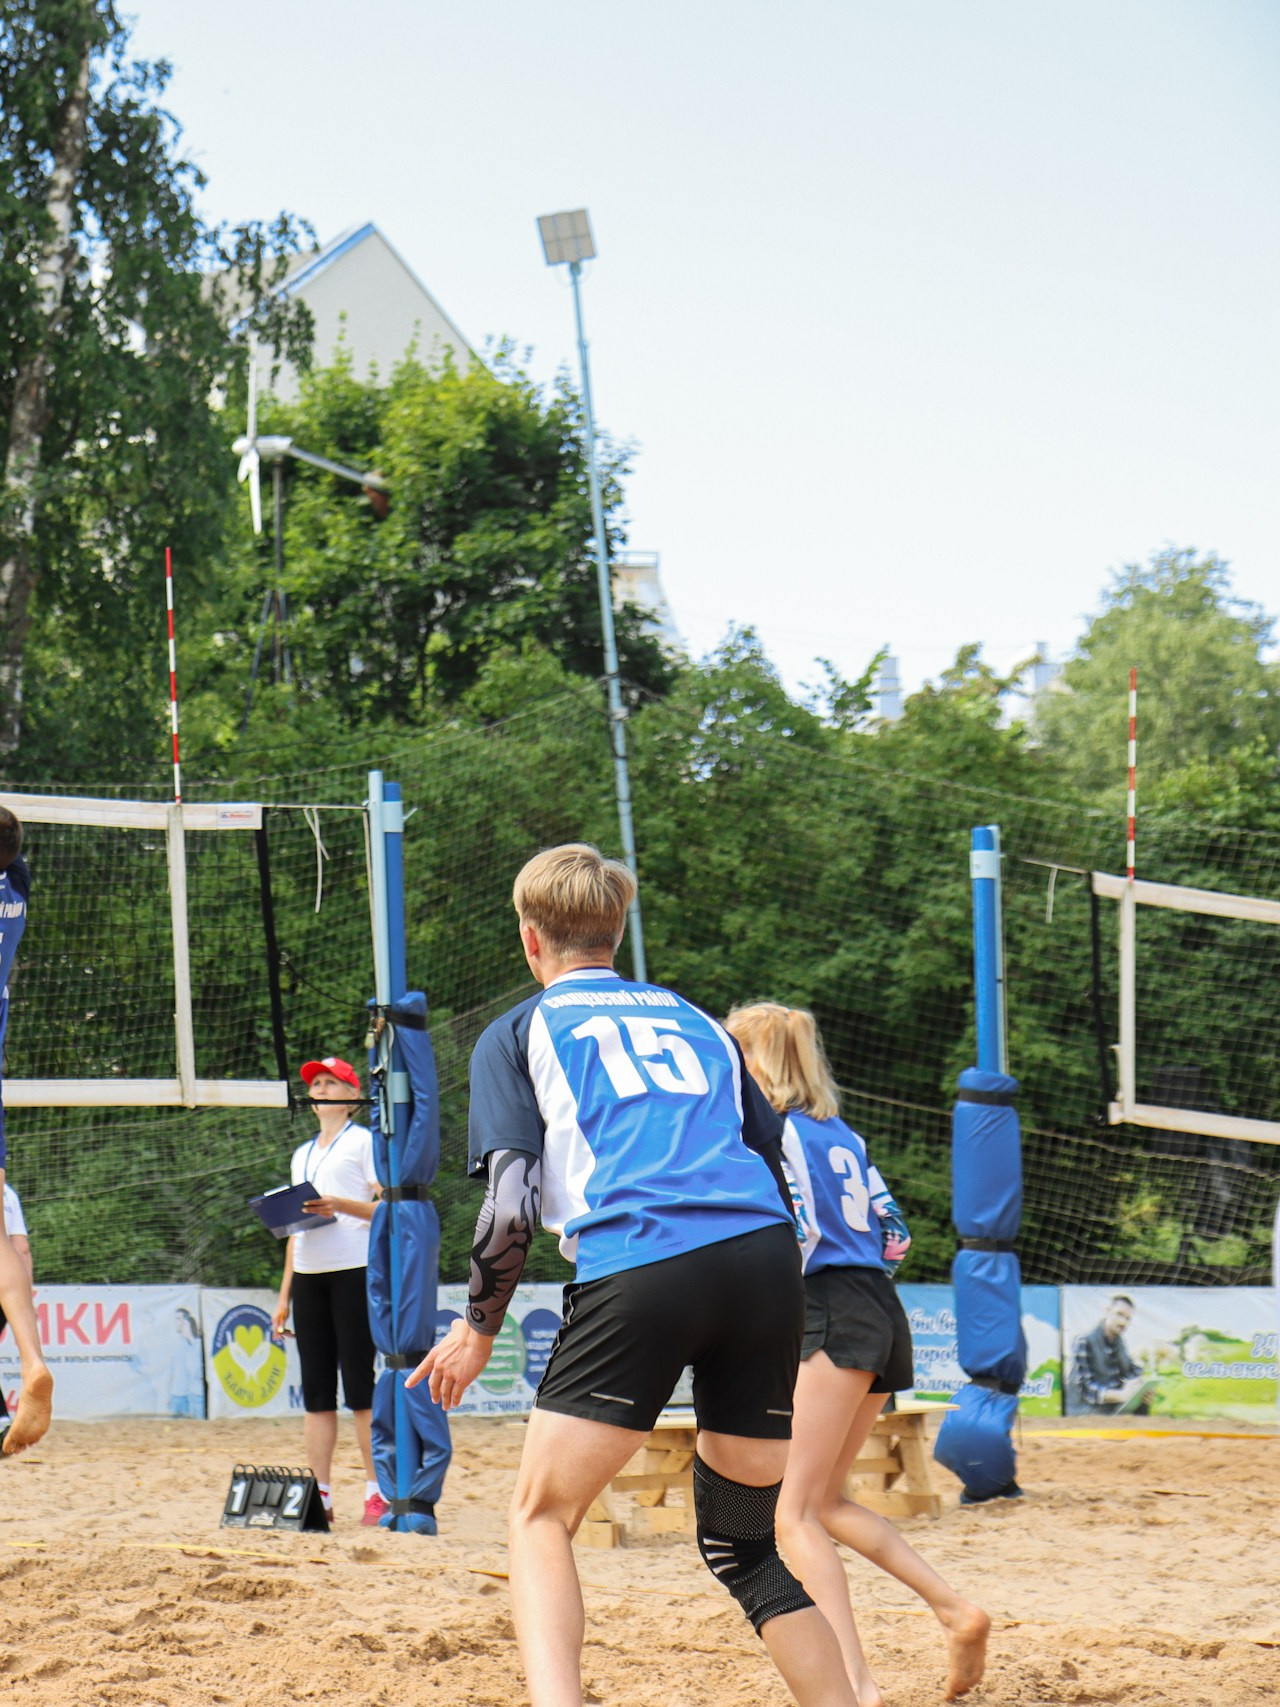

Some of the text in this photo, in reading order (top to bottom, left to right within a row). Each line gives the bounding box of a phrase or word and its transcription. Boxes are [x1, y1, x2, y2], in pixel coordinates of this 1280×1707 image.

[631, 990, 680, 1008] РАЙОН
[571, 1015, 710, 1099] 15
[828, 1145, 872, 1232] 3
[232, 1481, 304, 1516] 1 2
